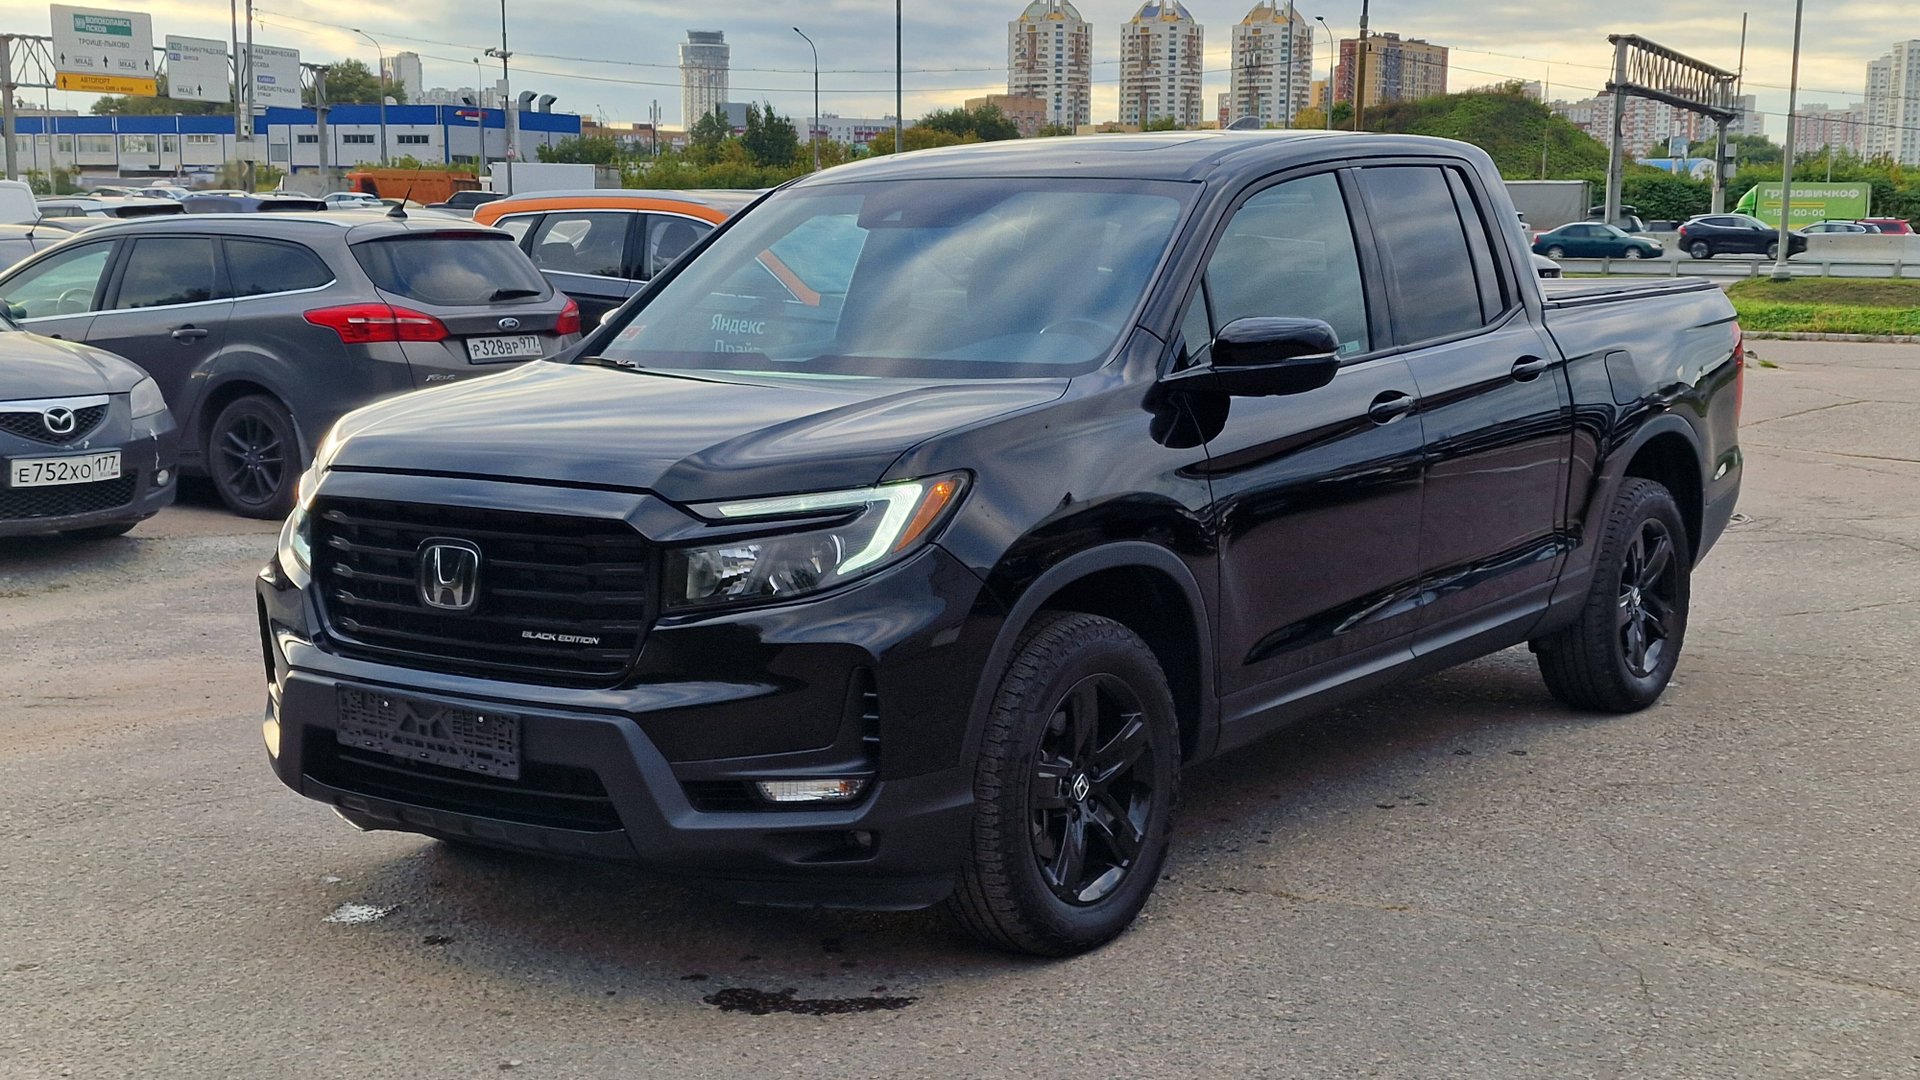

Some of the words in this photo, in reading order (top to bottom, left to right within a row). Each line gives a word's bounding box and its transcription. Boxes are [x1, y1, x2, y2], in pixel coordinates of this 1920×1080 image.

[711, 313, 766, 335] Яндекс
[95, 455, 117, 472] 177
[521, 630, 556, 642] BLACK
[558, 633, 600, 645] EDITION
